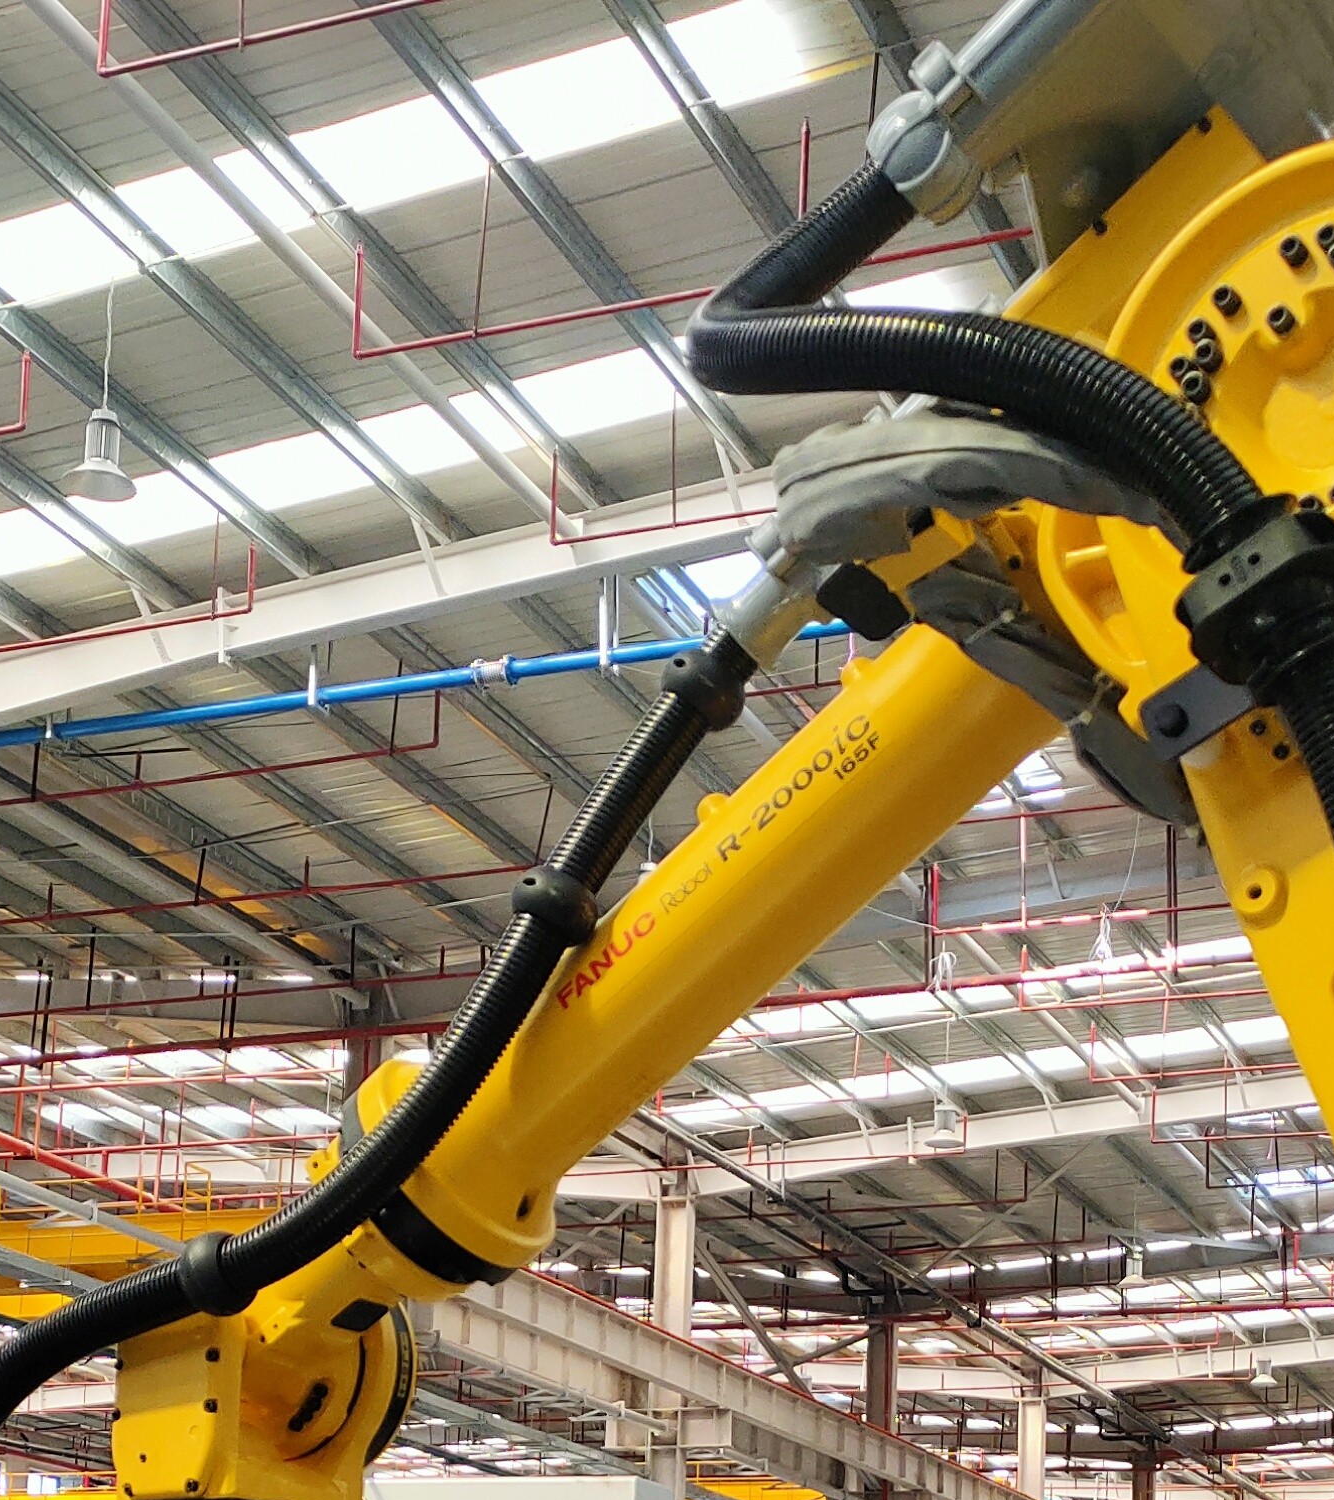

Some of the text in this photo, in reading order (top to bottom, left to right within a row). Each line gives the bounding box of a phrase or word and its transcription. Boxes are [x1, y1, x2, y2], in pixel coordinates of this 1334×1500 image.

[833, 731, 881, 781] 165F
[556, 911, 656, 1010] FANUC
[661, 861, 714, 914] Robot
